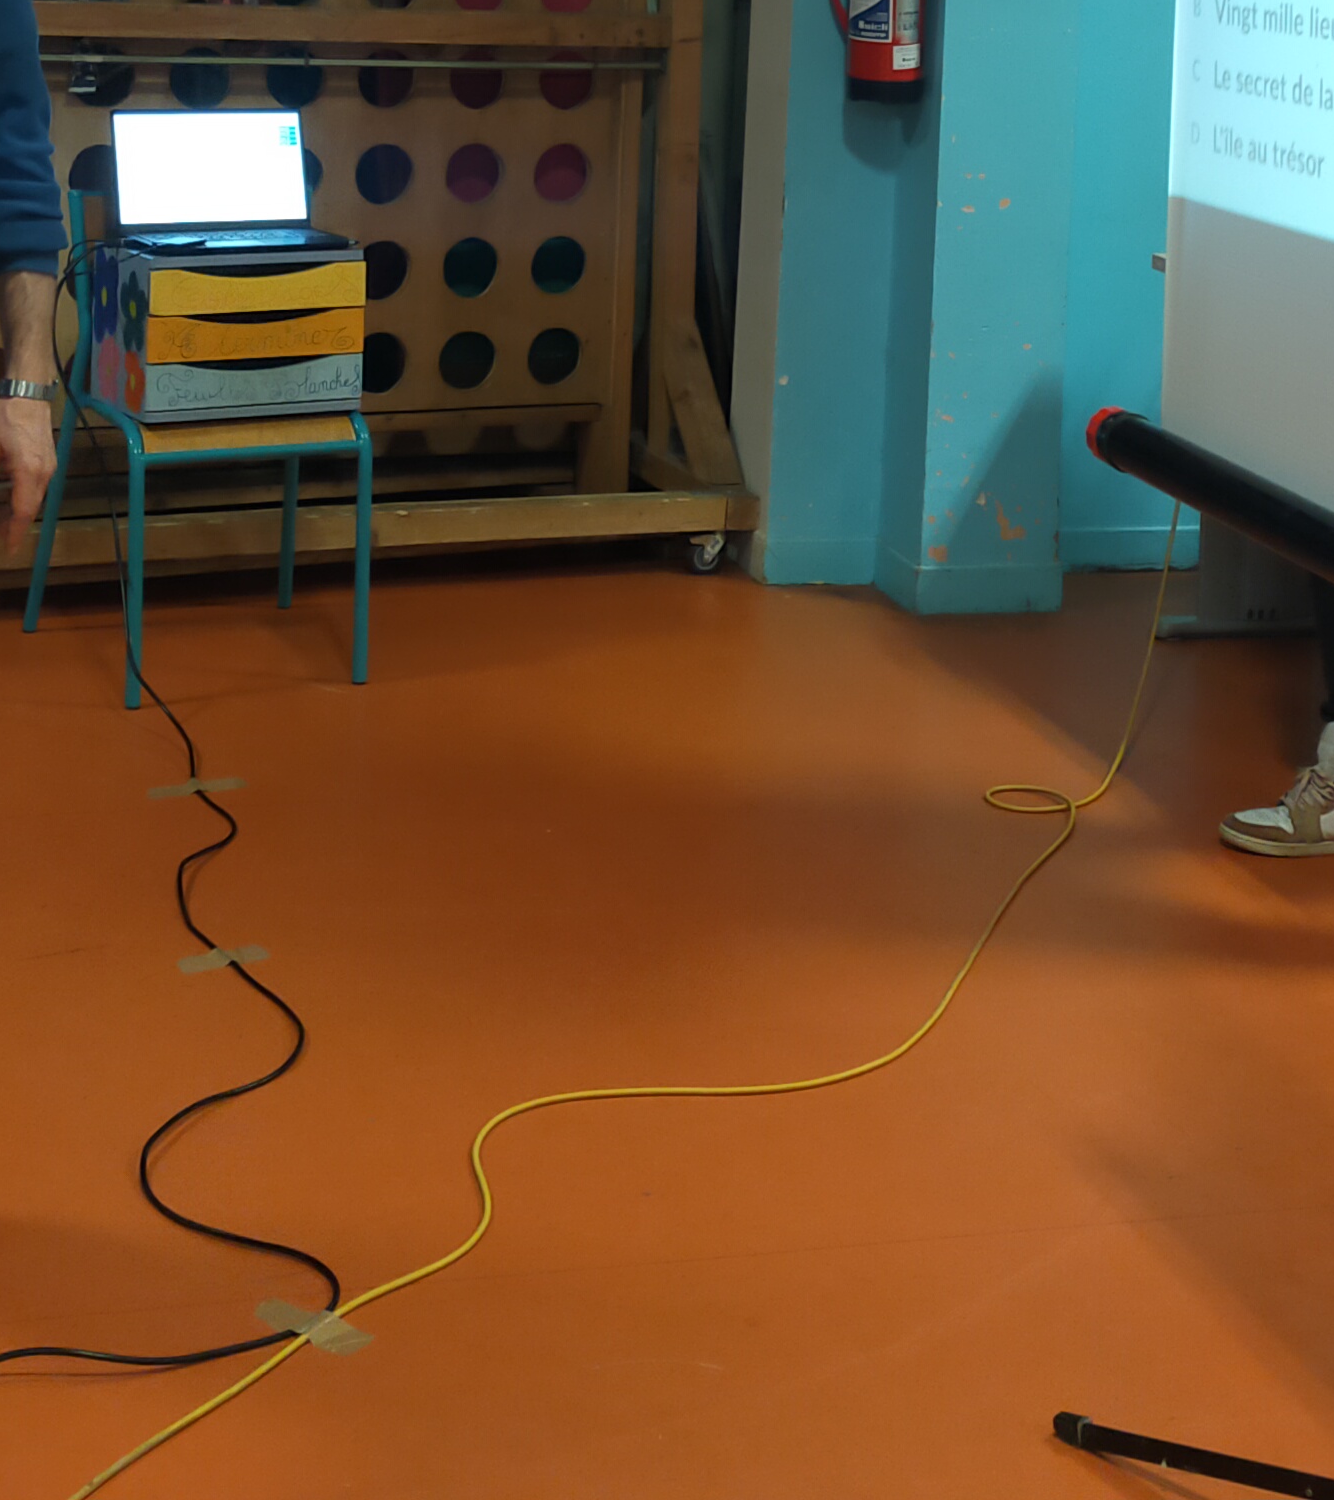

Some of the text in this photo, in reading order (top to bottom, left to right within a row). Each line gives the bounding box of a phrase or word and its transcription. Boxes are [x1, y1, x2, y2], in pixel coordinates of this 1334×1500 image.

[1264, 2, 1304, 37] mille
[1214, 60, 1231, 91] Le
[1236, 70, 1286, 103] secret
[1292, 74, 1313, 107] de
[1319, 78, 1334, 111] la
[1248, 142, 1267, 164] au
[1272, 141, 1325, 179] trésor
